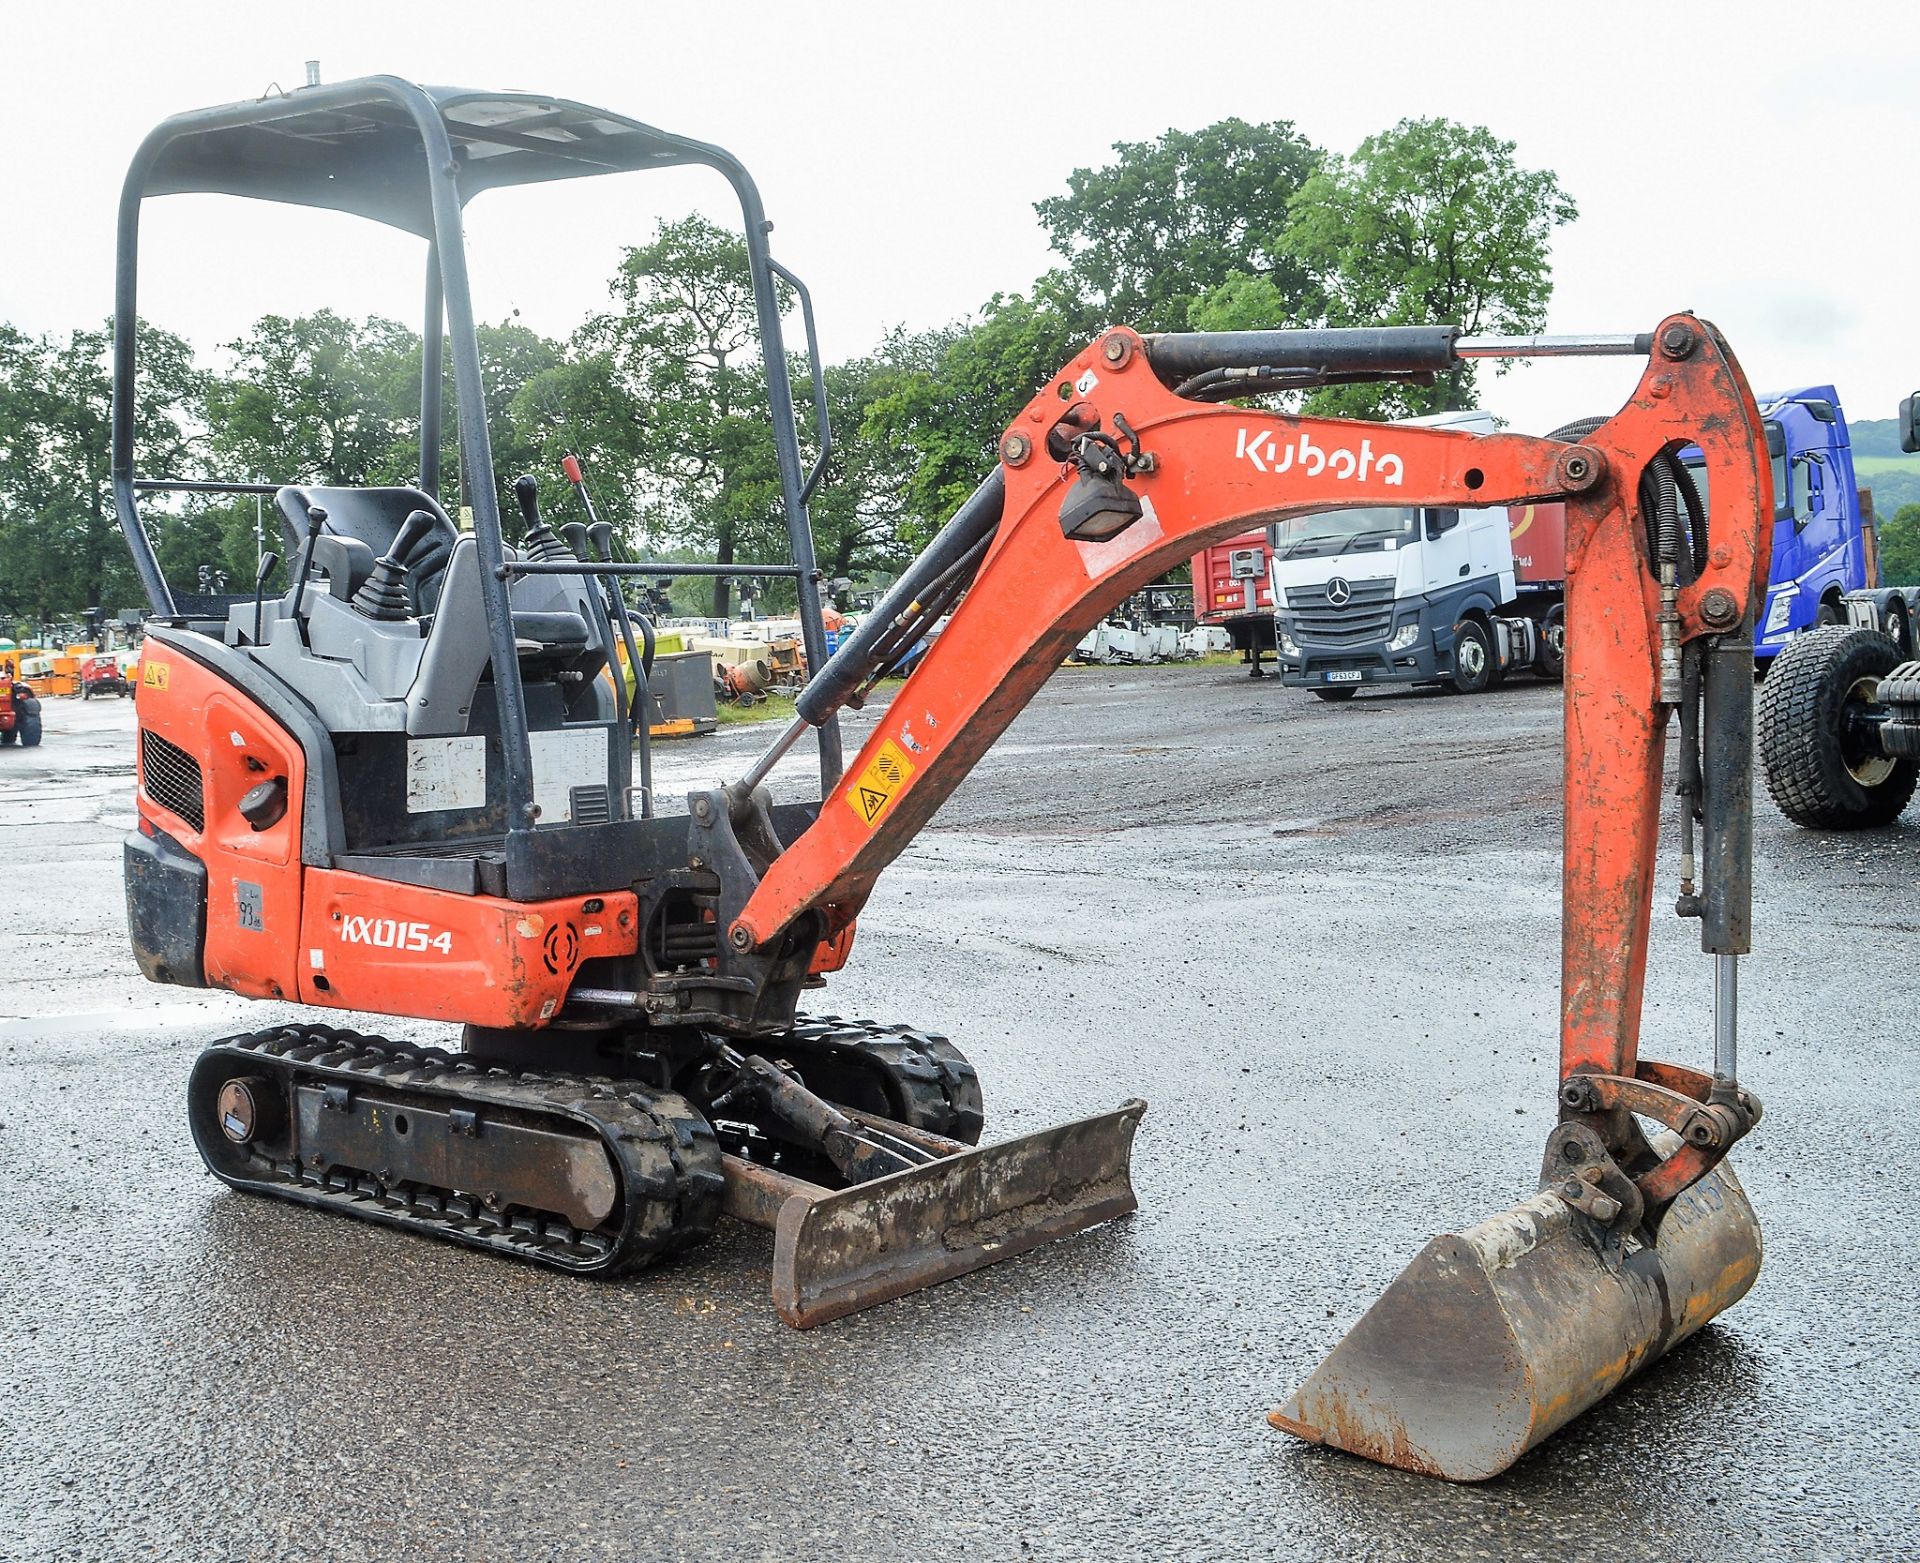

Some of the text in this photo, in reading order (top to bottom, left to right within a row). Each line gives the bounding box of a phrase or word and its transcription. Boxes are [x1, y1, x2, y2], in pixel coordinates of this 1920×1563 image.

[1235, 428, 1404, 486] Kubota
[239, 901, 253, 926] 93
[341, 914, 453, 955] KX015-4
